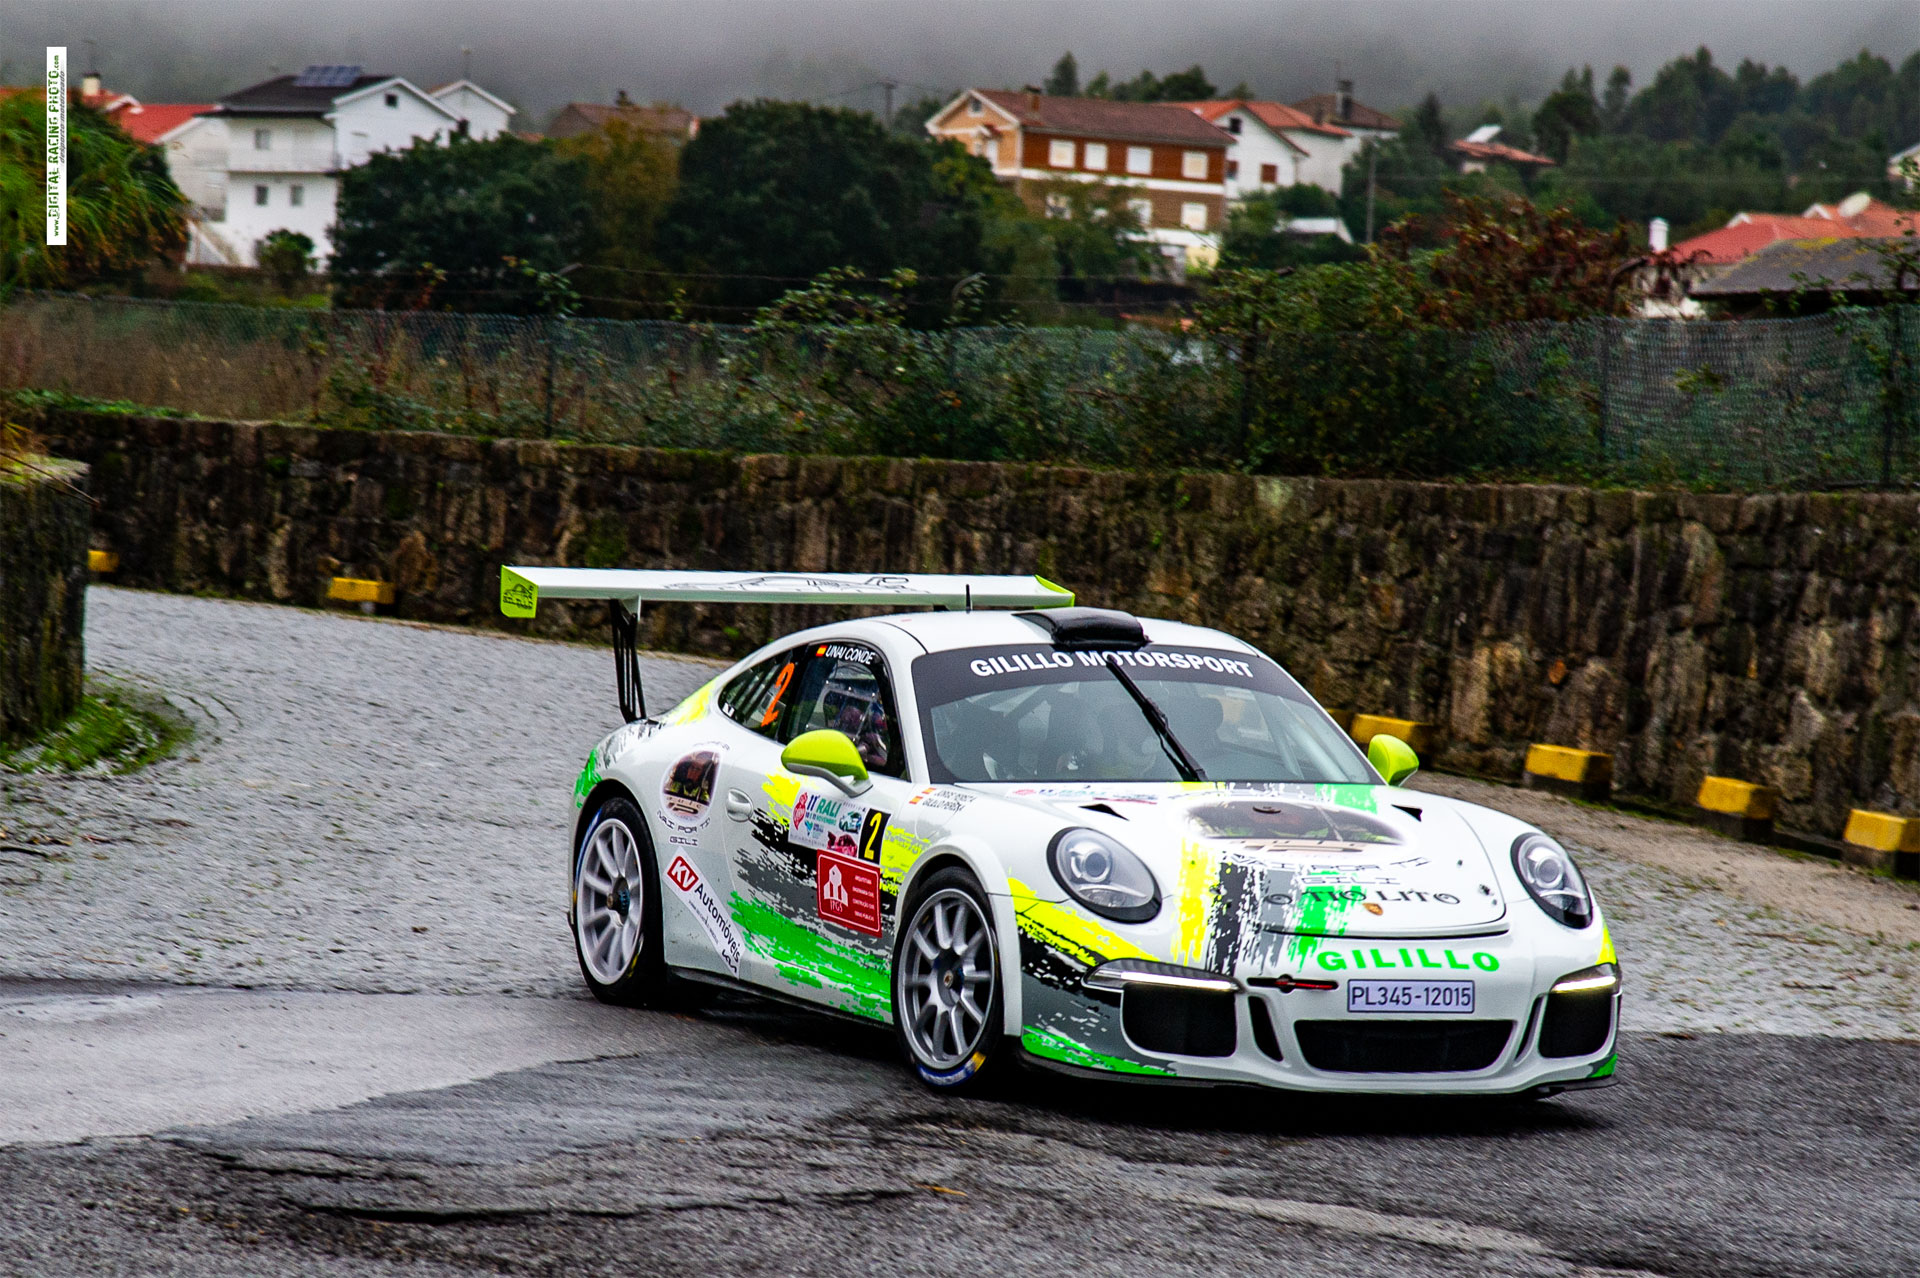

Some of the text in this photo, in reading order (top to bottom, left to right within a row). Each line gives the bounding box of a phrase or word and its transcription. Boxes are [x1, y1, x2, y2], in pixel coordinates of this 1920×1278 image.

[825, 644, 875, 665] UNAI CONDE
[970, 650, 1254, 678] GILILLO MOTORSPORT
[761, 662, 796, 728] 2
[816, 797, 842, 818] RALI
[677, 825, 698, 834] POR
[864, 812, 883, 860] 2
[669, 836, 698, 846] GILI
[1302, 889, 1367, 903] TIO
[1377, 889, 1462, 905] LITO
[672, 860, 695, 888] KV
[694, 882, 741, 963] Automóveis
[1317, 947, 1500, 972] GILILLO
[1351, 986, 1472, 1008] PL345-12015
